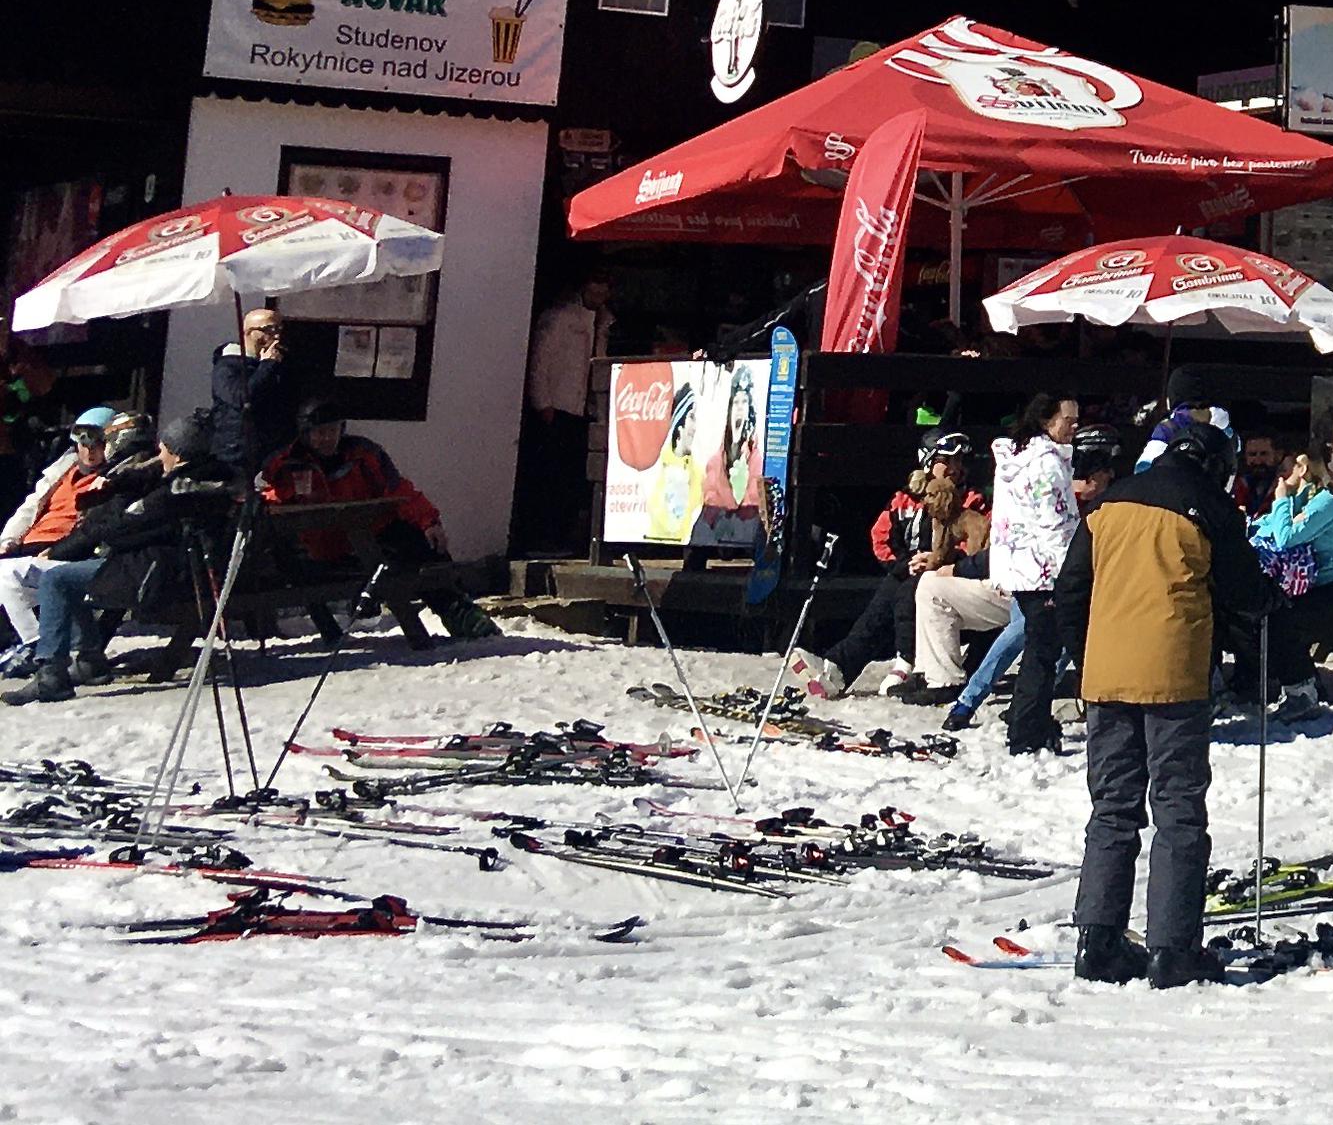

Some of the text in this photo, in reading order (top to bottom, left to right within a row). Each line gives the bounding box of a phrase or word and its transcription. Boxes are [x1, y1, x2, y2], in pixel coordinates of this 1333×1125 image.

[336, 25, 447, 54] Studenov
[250, 44, 521, 87] Rokytnice nad Jizerou
[1191, 157, 1219, 169] pivo
[1172, 271, 1244, 292] Gambrinus
